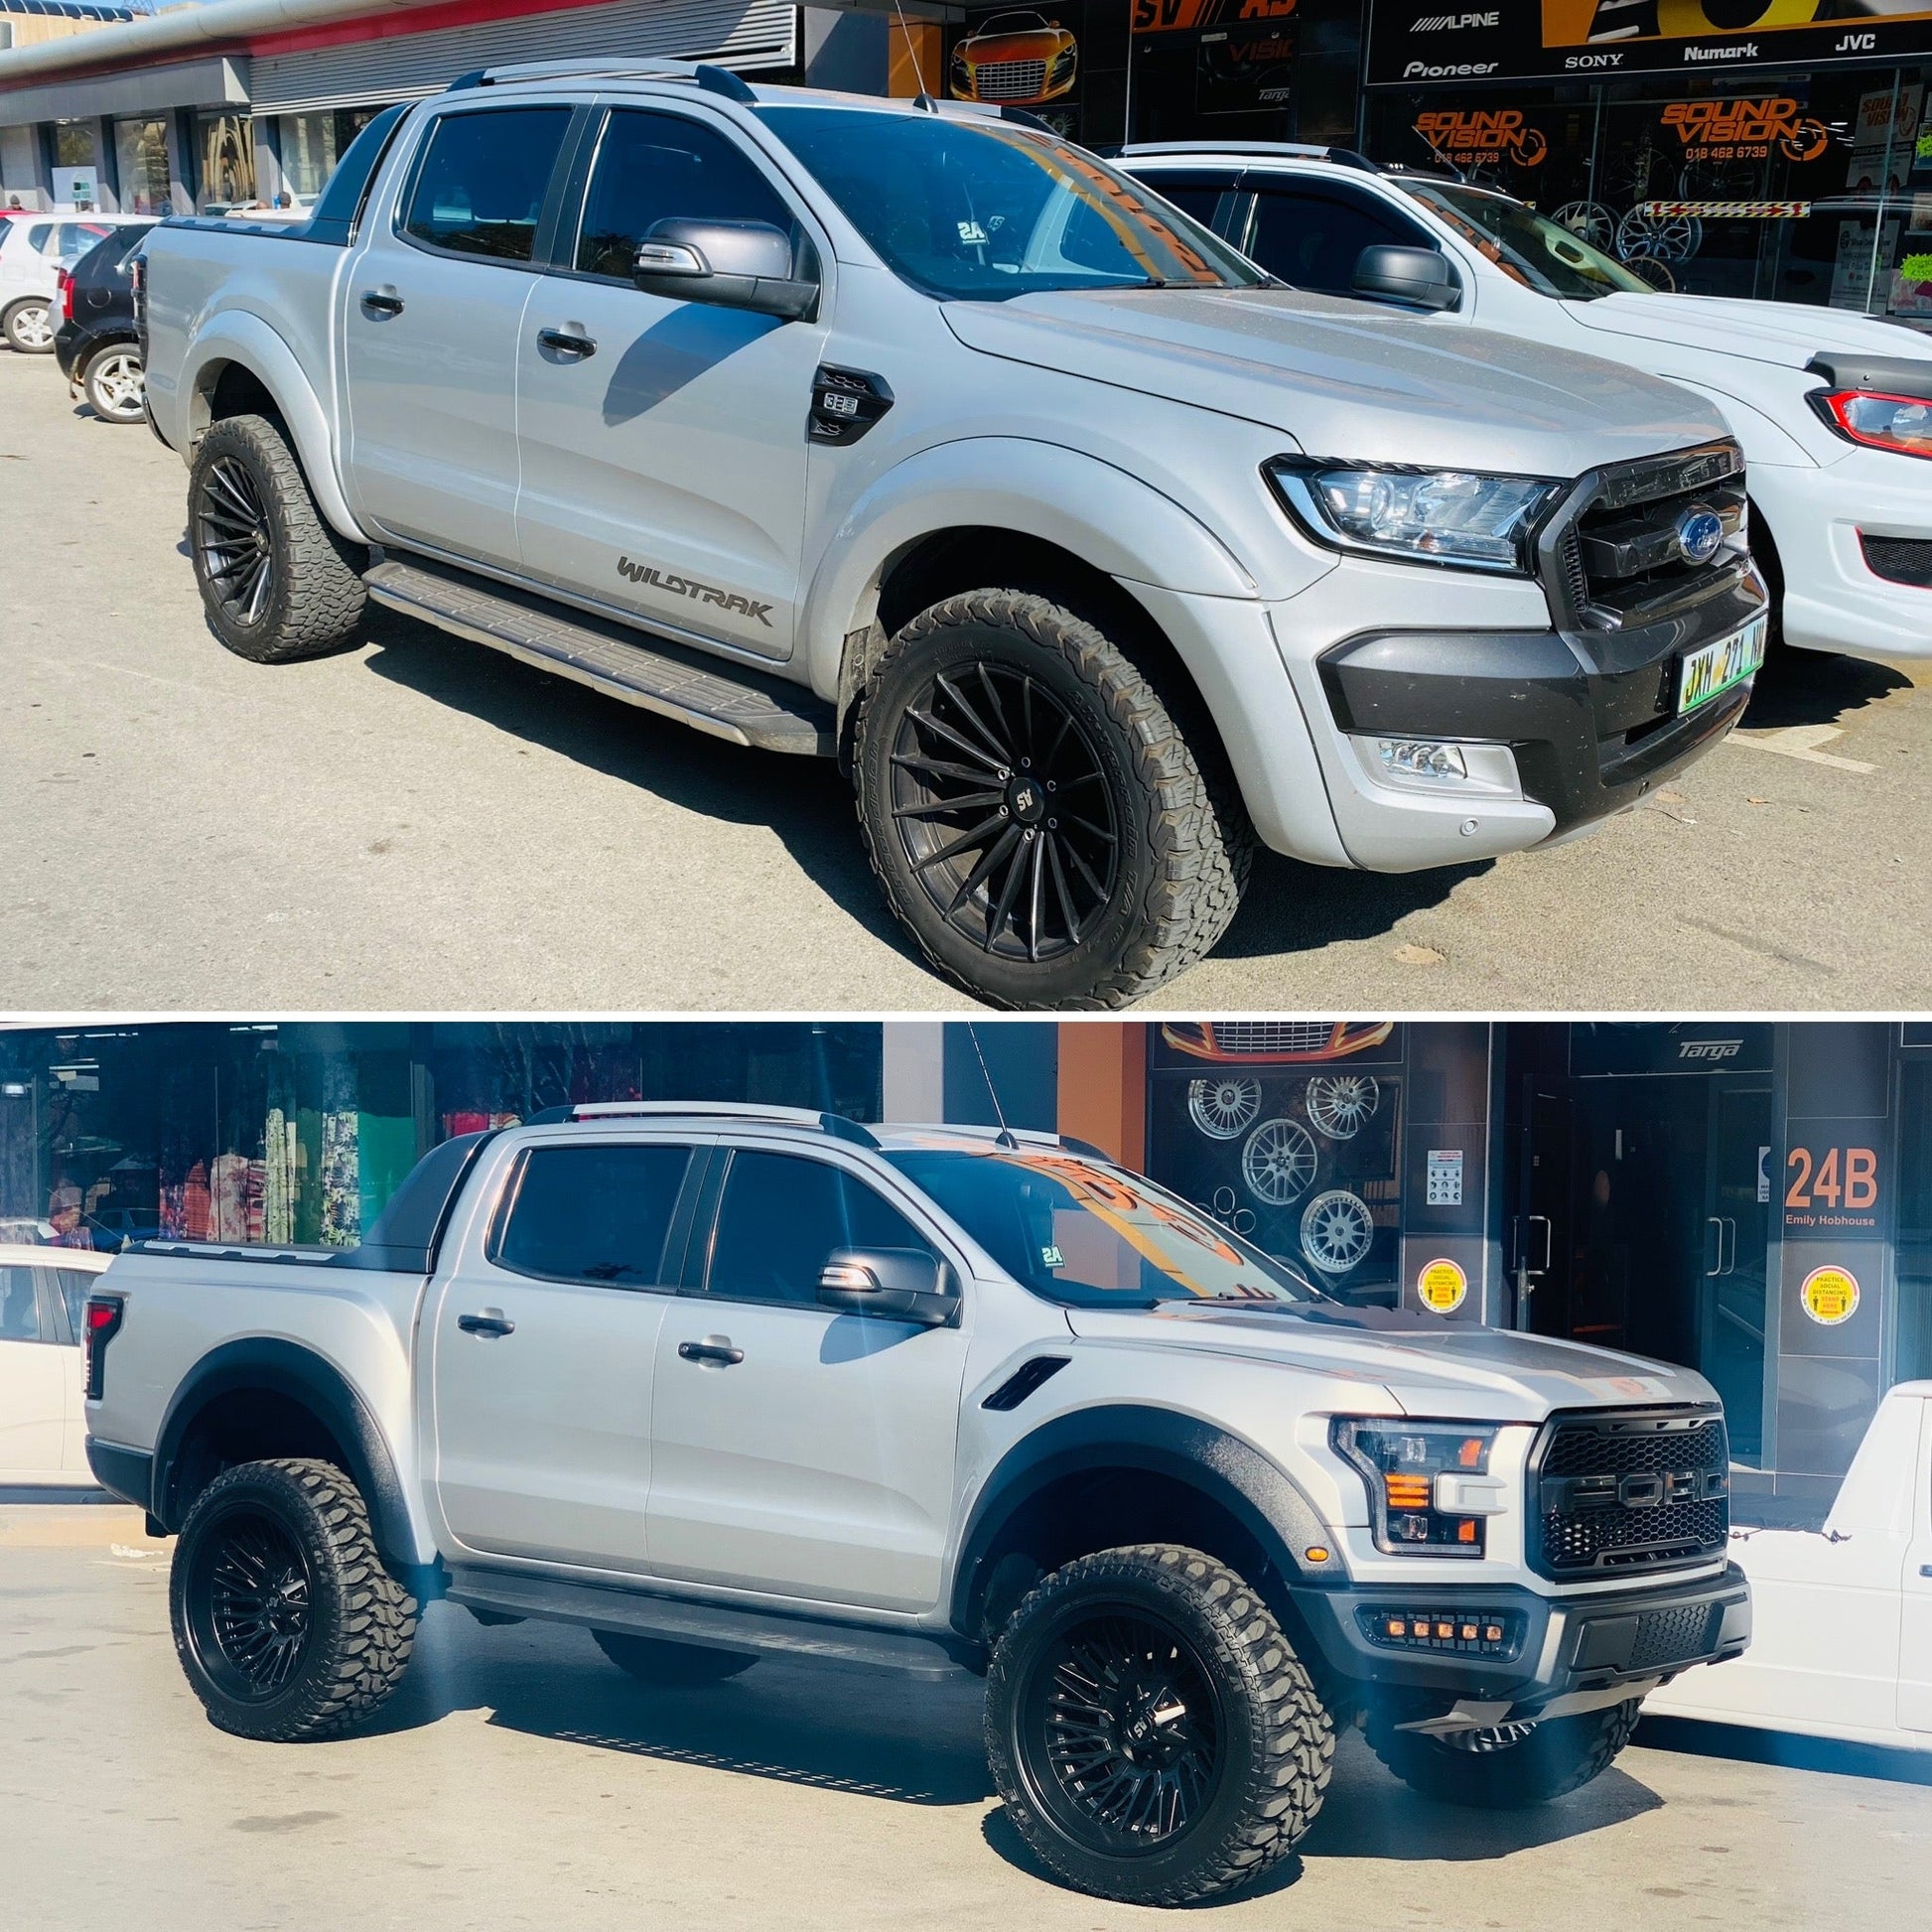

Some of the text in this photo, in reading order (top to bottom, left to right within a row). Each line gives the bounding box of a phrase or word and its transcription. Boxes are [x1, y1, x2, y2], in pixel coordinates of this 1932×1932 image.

[1435, 12, 1500, 30] ALPINE
[1836, 34, 1875, 51] JVC
[1565, 54, 1624, 69] SONY
[1684, 43, 1759, 62] Numark
[1402, 61, 1499, 78] Pioneer
[1416, 110, 1524, 131] SOUND
[1660, 98, 1798, 125] SOUND
[1428, 128, 1527, 148] VISION
[1675, 118, 1803, 143] VISION
[1454, 152, 1473, 164] 462
[1475, 151, 1500, 164] 6739
[1686, 146, 1767, 160] 018 462 6739
[617, 556, 773, 627] WILDTRAK
[1721, 632, 1744, 684] 271
[1678, 1039, 1743, 1060] Targa
[1785, 1148, 1877, 1208] 24B
[1786, 1214, 1875, 1227] Emily Hobhouse
